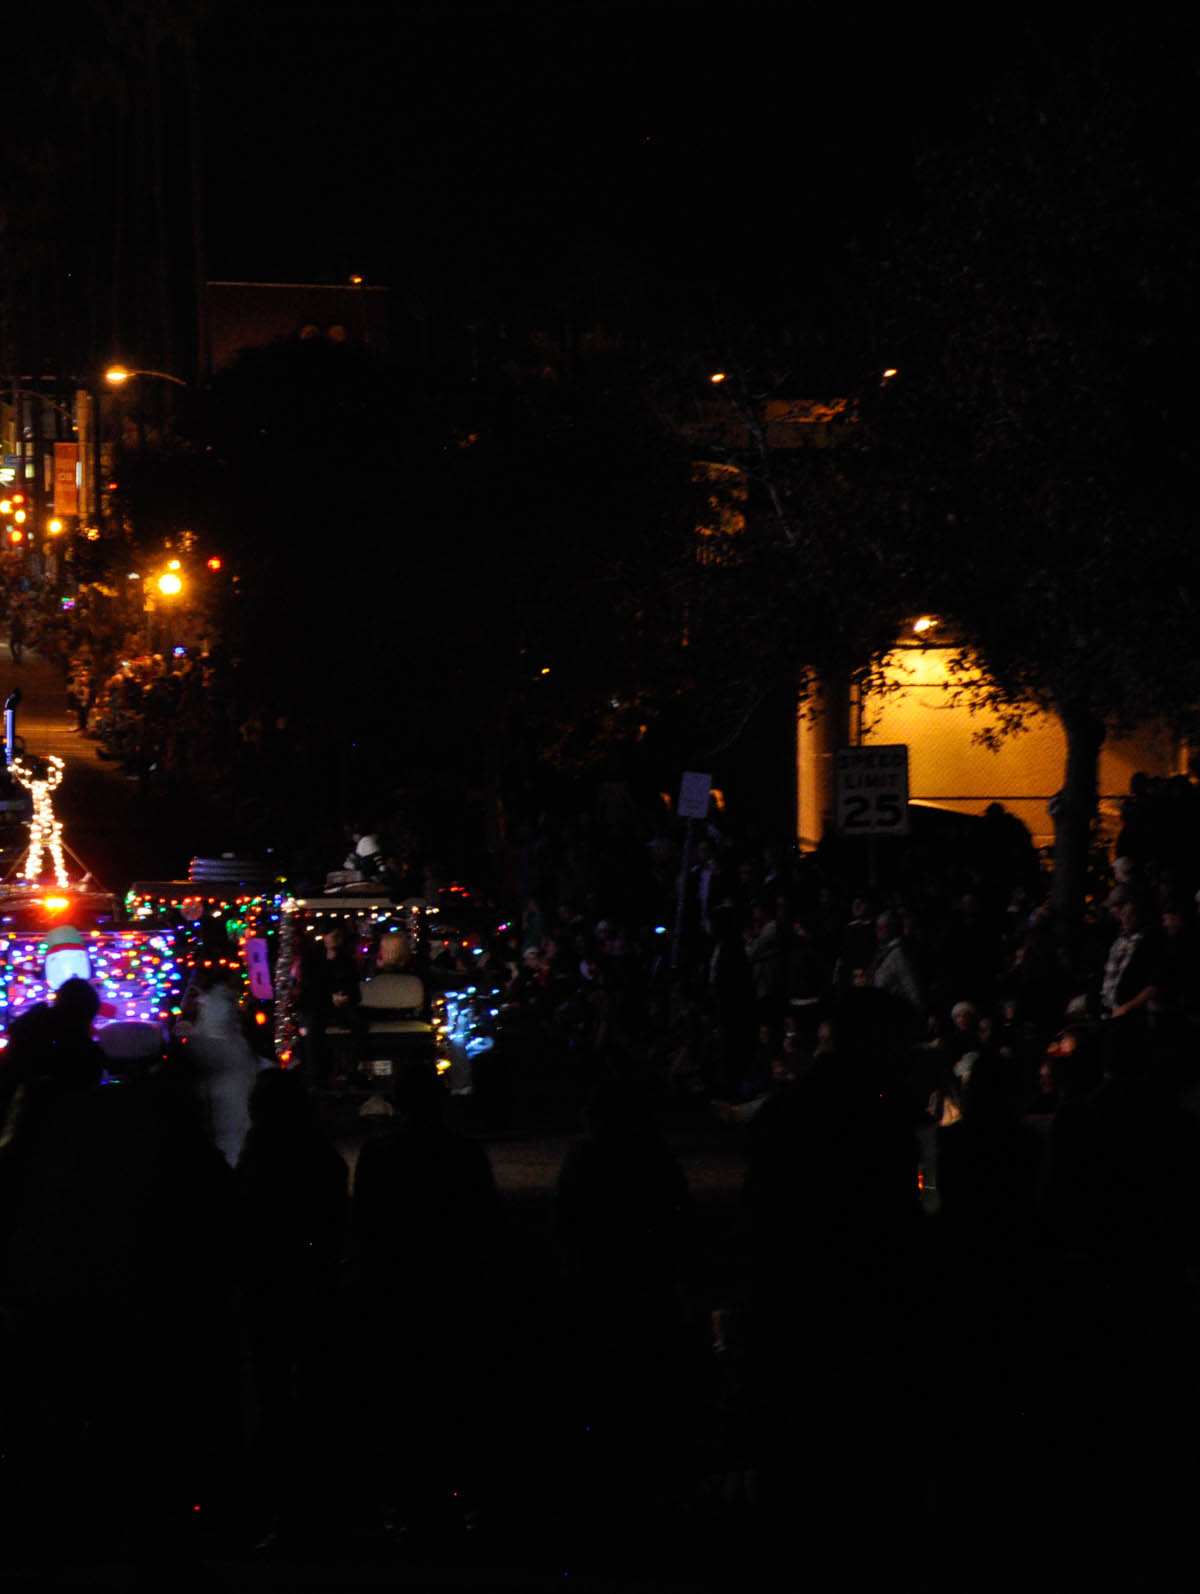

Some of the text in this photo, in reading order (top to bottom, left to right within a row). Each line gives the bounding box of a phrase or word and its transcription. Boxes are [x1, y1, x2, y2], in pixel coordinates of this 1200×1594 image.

[841, 753, 902, 769] SPEED
[845, 773, 898, 788] LIMIT
[845, 795, 902, 827] 25
